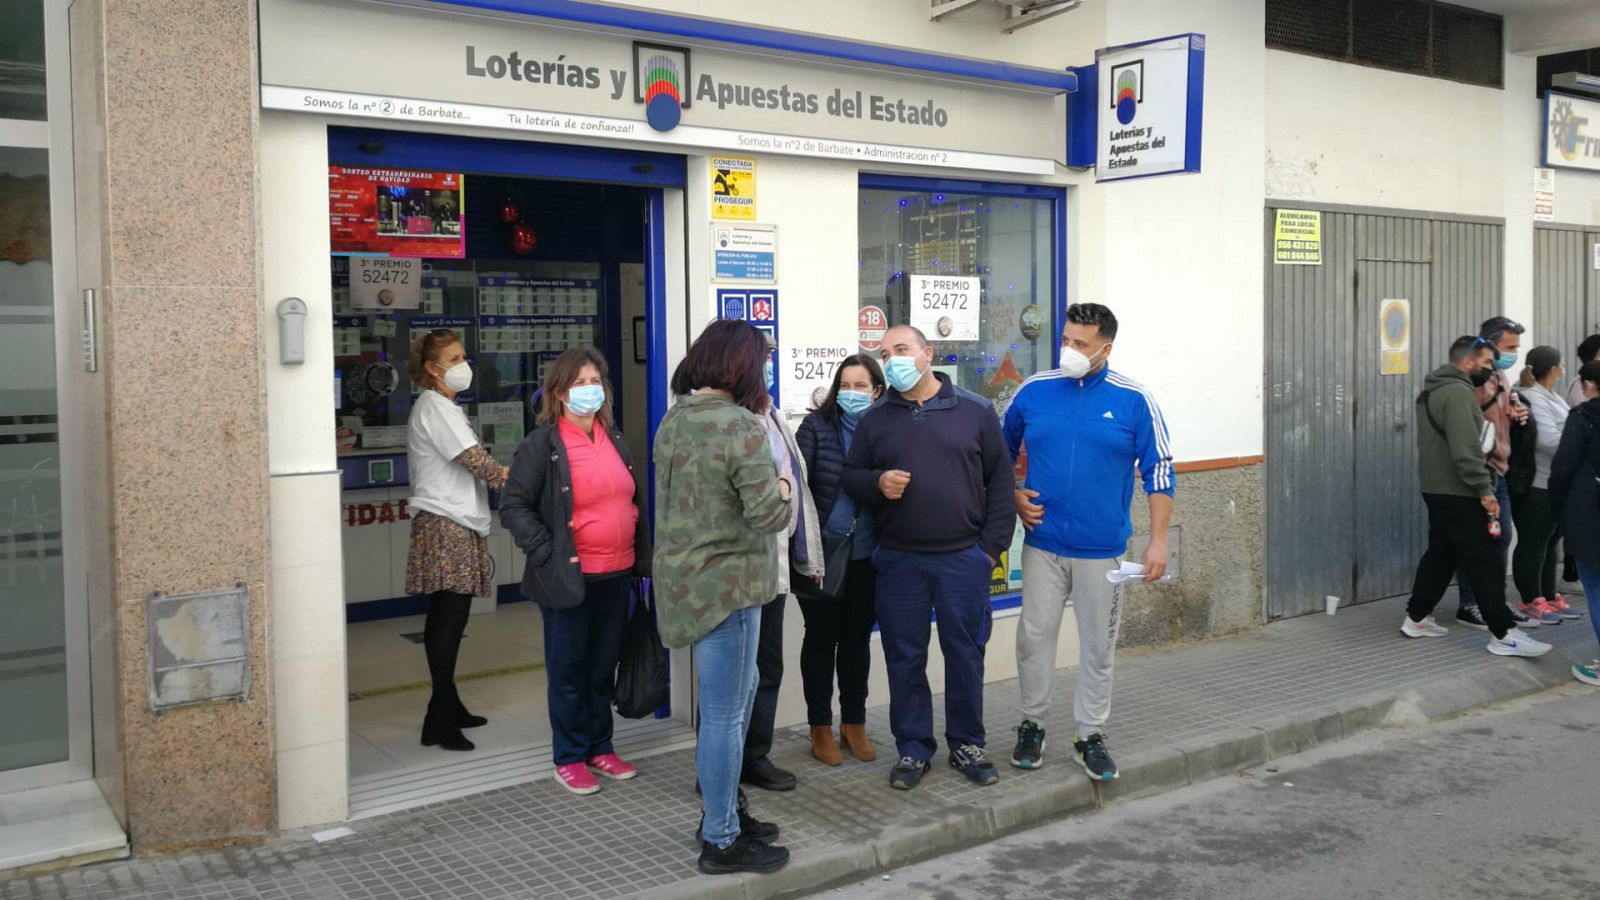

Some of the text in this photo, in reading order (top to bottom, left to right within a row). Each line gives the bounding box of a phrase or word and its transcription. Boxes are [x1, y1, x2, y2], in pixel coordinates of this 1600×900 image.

[465, 45, 948, 127] Loterías y Apuestas del Estado
[303, 95, 344, 110] Somos
[348, 98, 359, 111] la
[399, 104, 414, 115] de
[507, 113, 635, 134] Tu lotería de confianza!!
[1110, 126, 1153, 141] Loterías y
[737, 135, 771, 148] Somos
[773, 136, 782, 149] la
[803, 140, 816, 152] de
[817, 141, 854, 155] Barbate
[864, 146, 929, 162] Administración
[1109, 136, 1166, 157] Apuestas del
[713, 159, 753, 168] CONECTADA
[1108, 155, 1138, 169] Estado
[714, 196, 754, 206] PROSEGUR
[373, 259, 412, 269] PREMIO
[362, 270, 410, 285] 52472
[933, 280, 970, 291] PREMIO
[922, 292, 968, 310] 52472
[860, 311, 880, 325] +18
[806, 348, 848, 358] PREMIO
